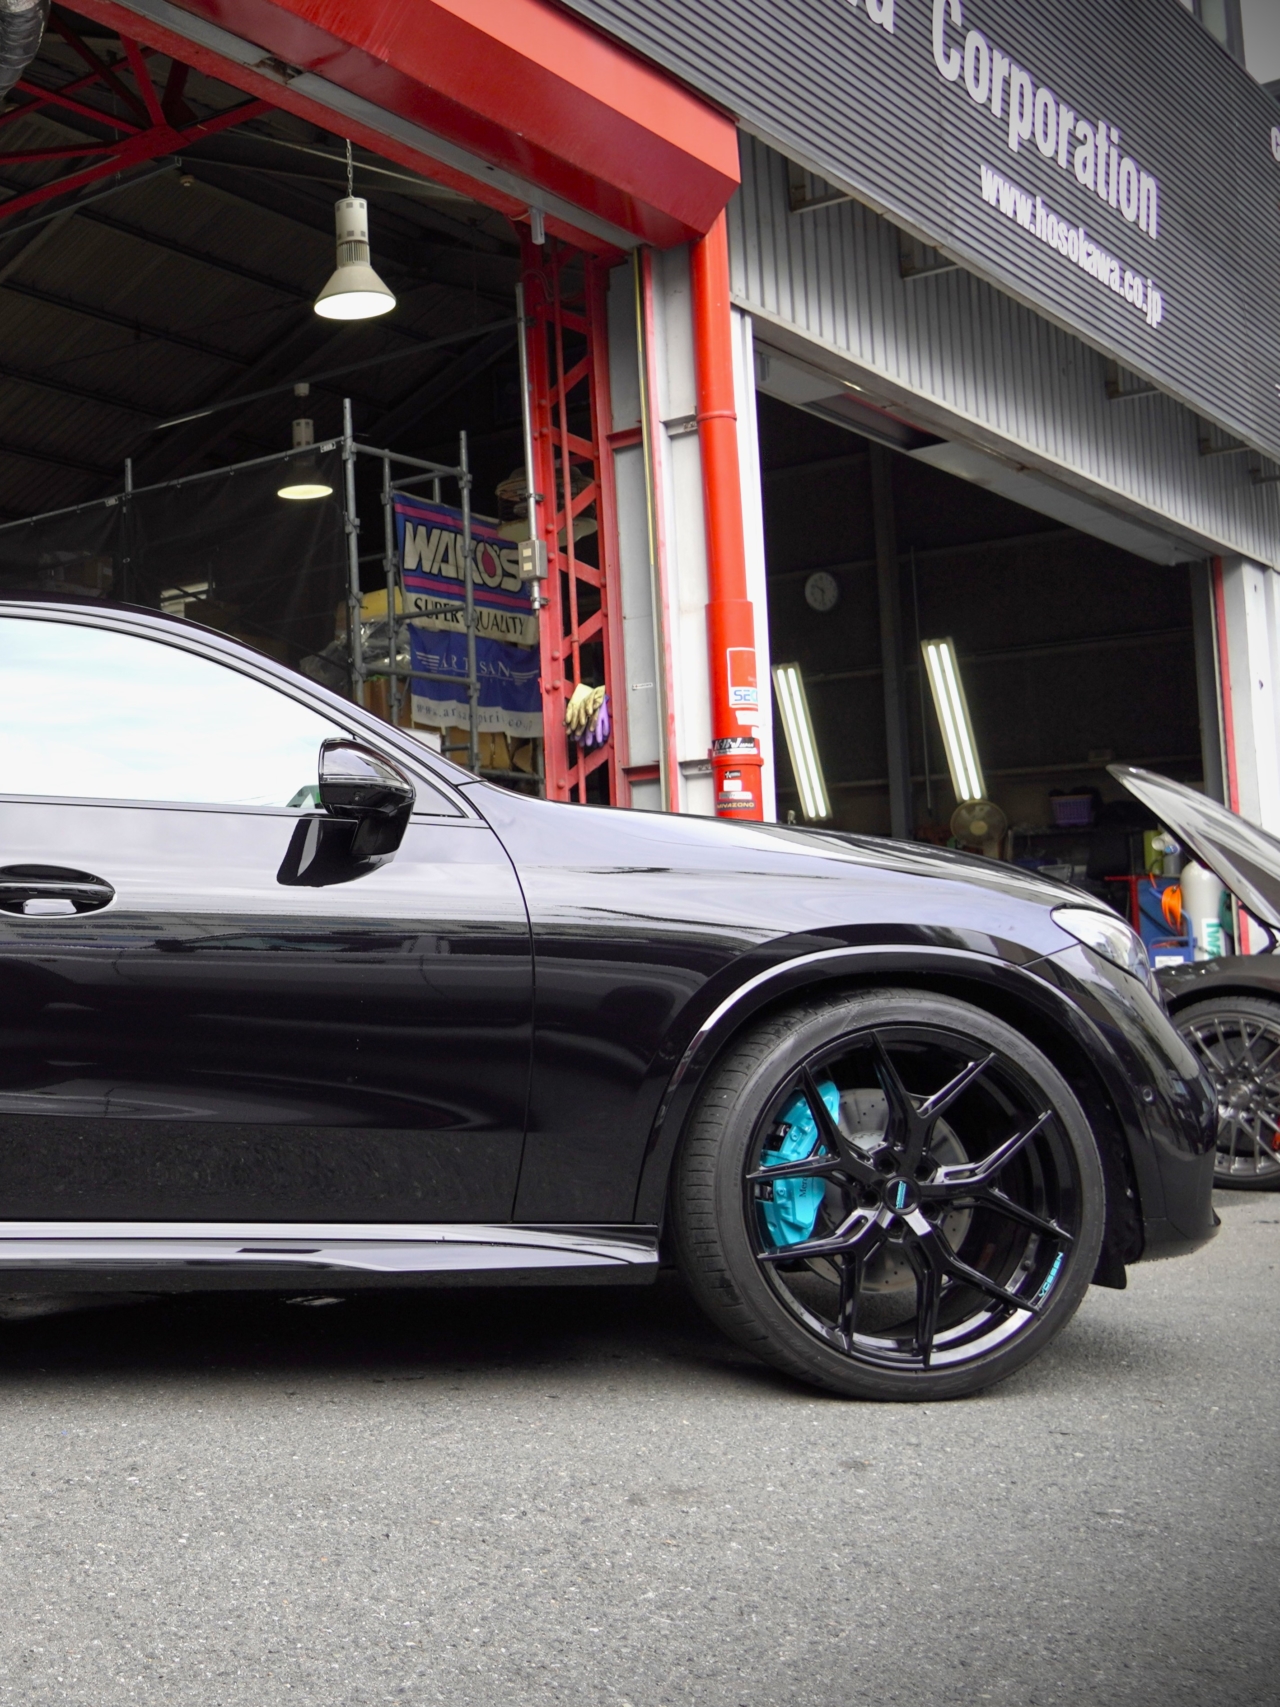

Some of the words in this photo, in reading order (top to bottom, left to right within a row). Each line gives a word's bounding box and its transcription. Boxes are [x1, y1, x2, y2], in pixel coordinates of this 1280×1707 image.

[932, 0, 1160, 240] Corporation
[980, 164, 1163, 328] www.hosokawa.co.jp
[404, 521, 522, 593] WAKO'S
[440, 652, 511, 677] ARTSAN
